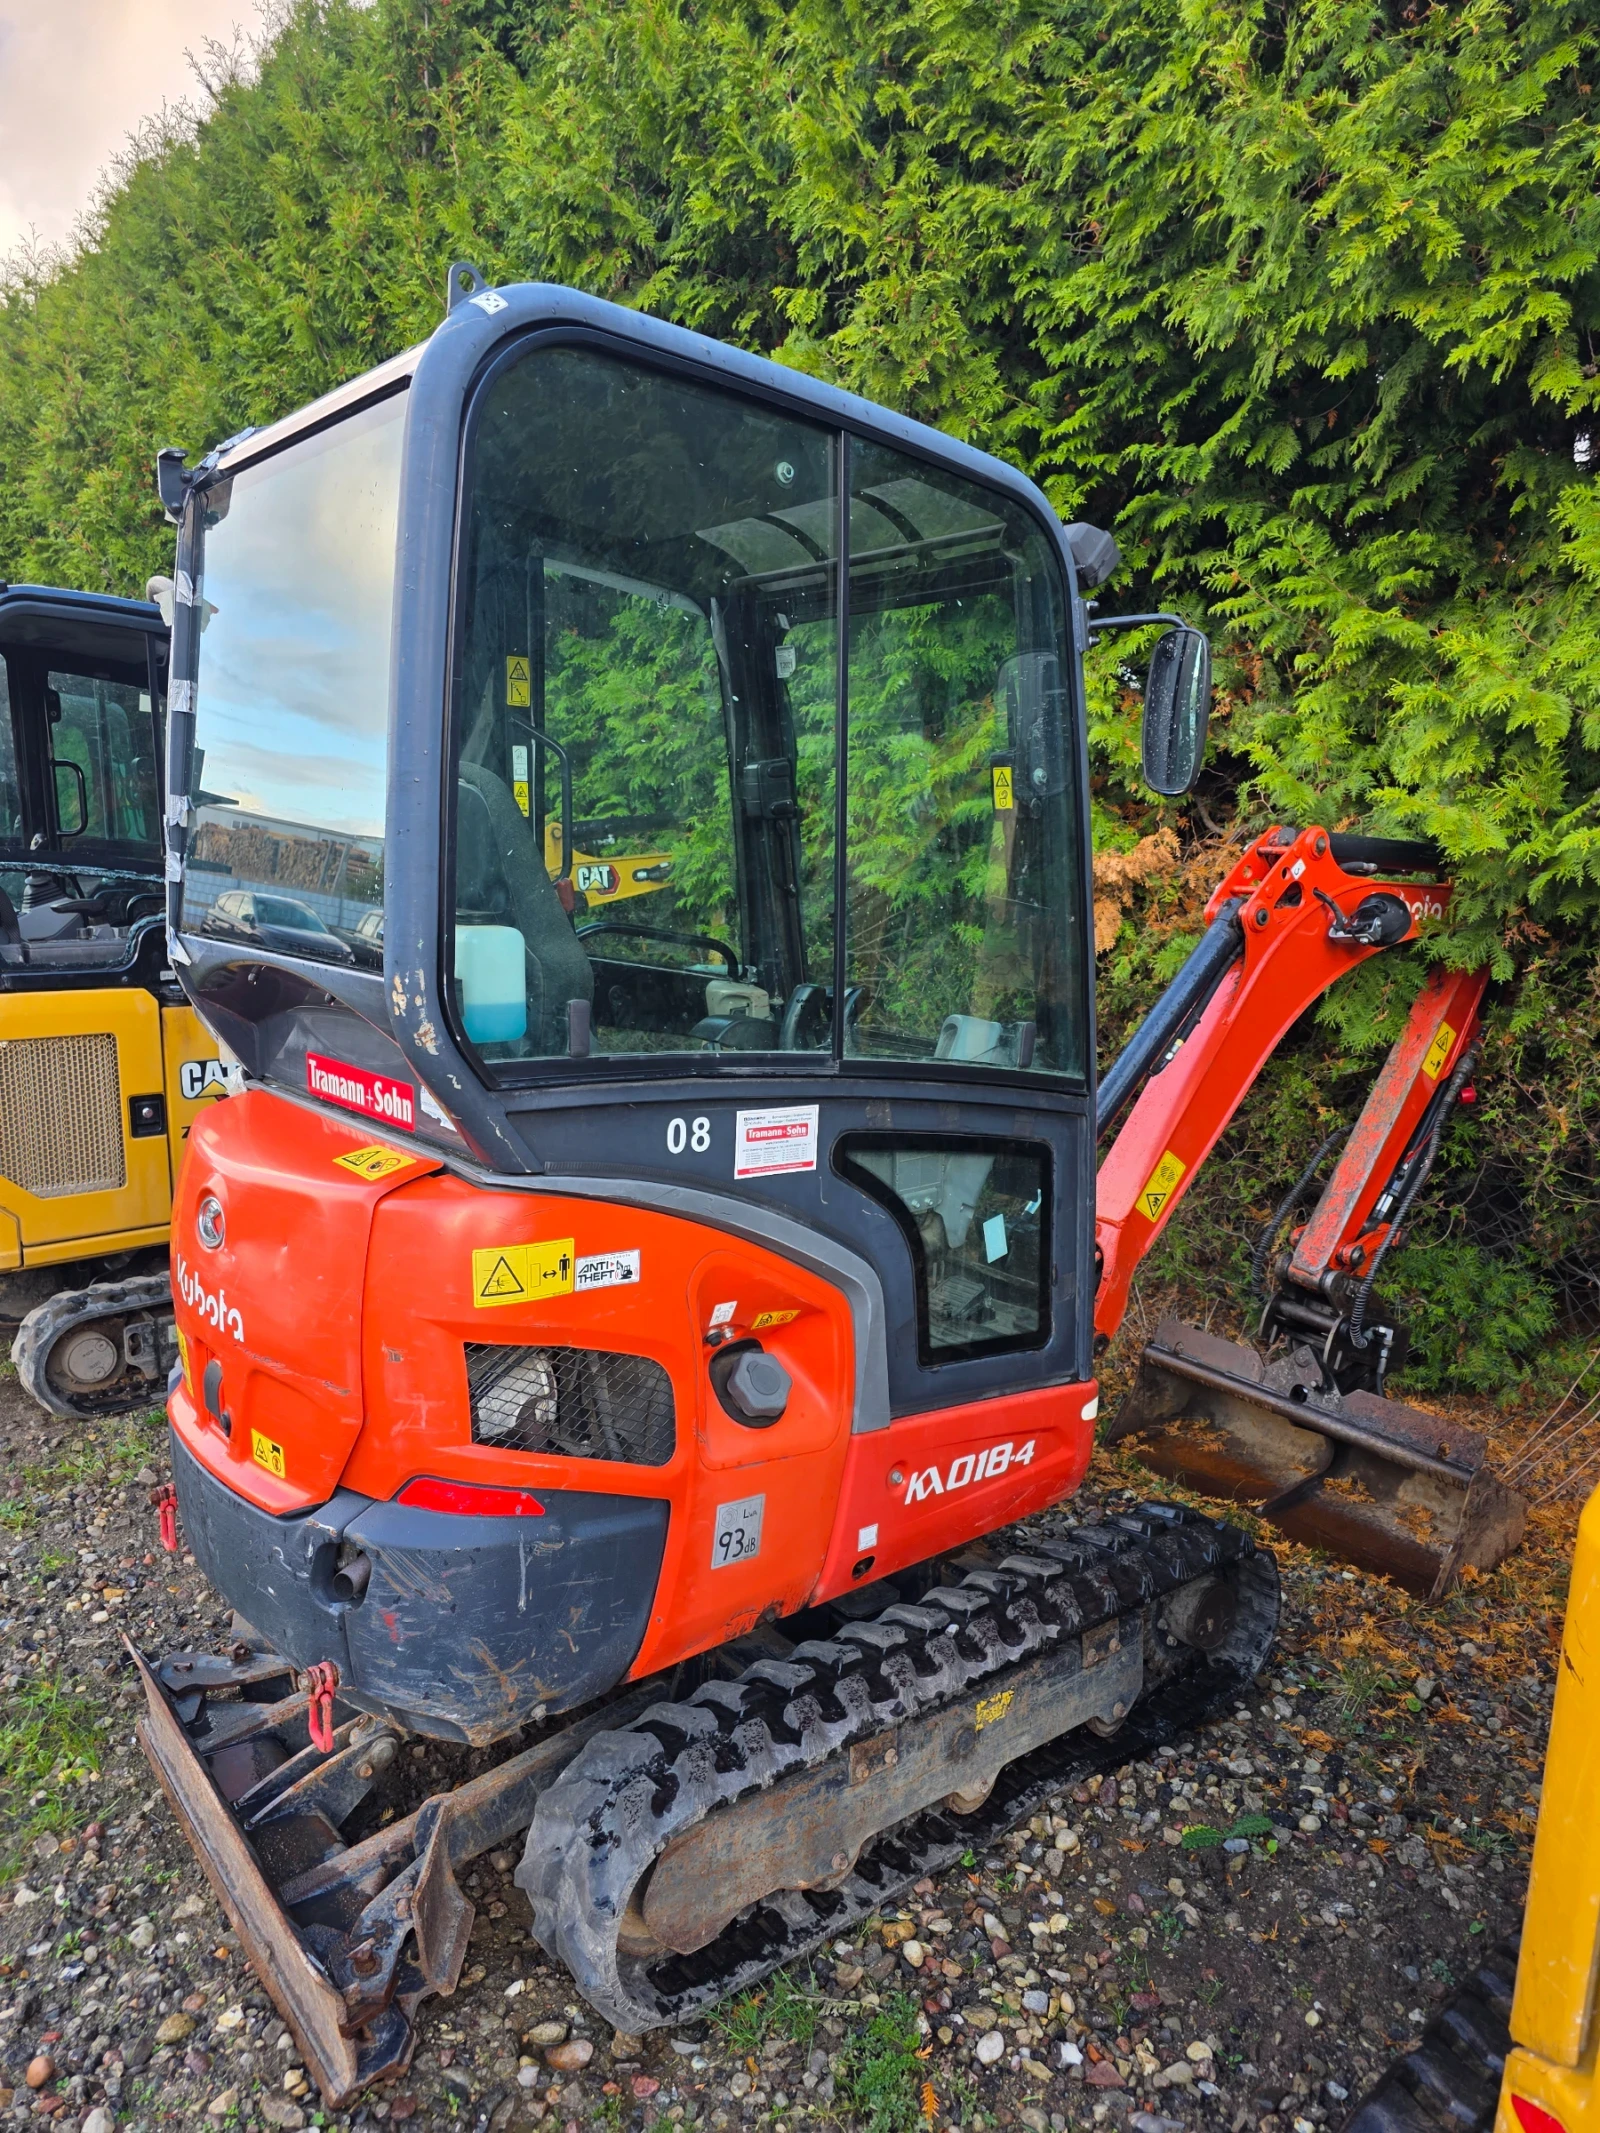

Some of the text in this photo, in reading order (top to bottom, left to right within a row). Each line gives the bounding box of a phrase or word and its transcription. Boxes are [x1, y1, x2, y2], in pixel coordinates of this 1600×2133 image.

[578, 865, 610, 891] CAT
[667, 1116, 710, 1154] 08
[578, 1261, 609, 1274] ANTI
[578, 1270, 615, 1283] THEFT
[177, 1253, 244, 1342] Kubota
